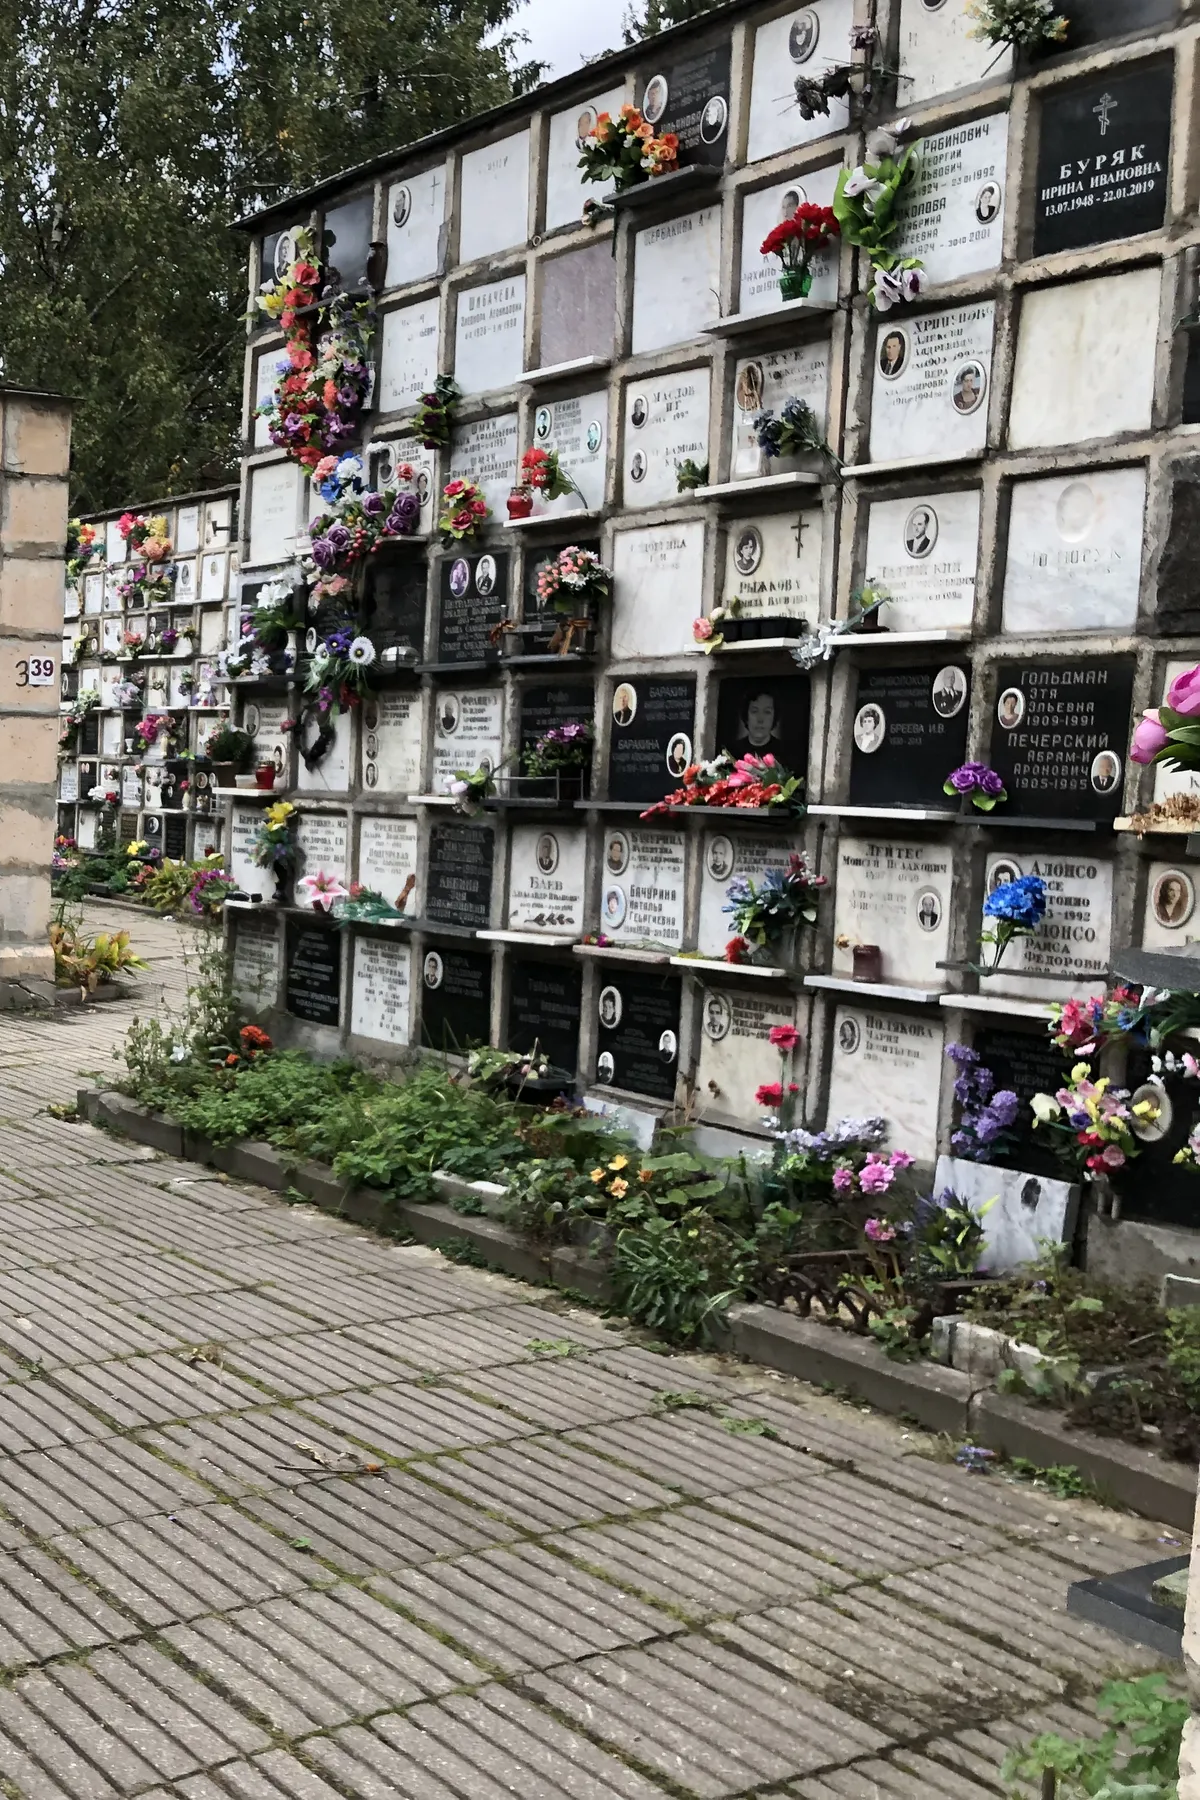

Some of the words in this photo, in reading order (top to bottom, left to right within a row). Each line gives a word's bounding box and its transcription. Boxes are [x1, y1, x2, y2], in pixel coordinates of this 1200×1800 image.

[923, 124, 990, 156] РАБИНОВИЧ
[1060, 144, 1146, 180] БУРЯК
[1041, 181, 1084, 201] ИРИНА
[1090, 161, 1162, 188] ИВАНОВНА
[1045, 194, 1094, 217] 13.07.1948
[1103, 179, 1155, 203] 22.01.2019
[30, 659, 55, 677] 39
[1021, 670, 1108, 685] ГОЛЬДМАН
[1029, 688, 1058, 700] ЭТЯ
[1028, 702, 1095, 713] ЭЛЬЕВНА
[1026, 715, 1094, 726] 1909-1991
[1007, 732, 1109, 748] ПЕЧЕРСКИЙ
[1027, 750, 1090, 763] АБРАМ-И
[1013, 762, 1089, 777] АРОНОВИЧ
[1015, 778, 1088, 790] 1905-1995
[1030, 860, 1098, 880] АЛОНСО
[529, 876, 564, 891] БАЕВ
[630, 884, 677, 901] БАЧУРИНА
[1038, 923, 1096, 942] ЛОНСО
[1025, 938, 1071, 954] РАИСА
[1024, 951, 1110, 971] ФЕДОРОВНА
